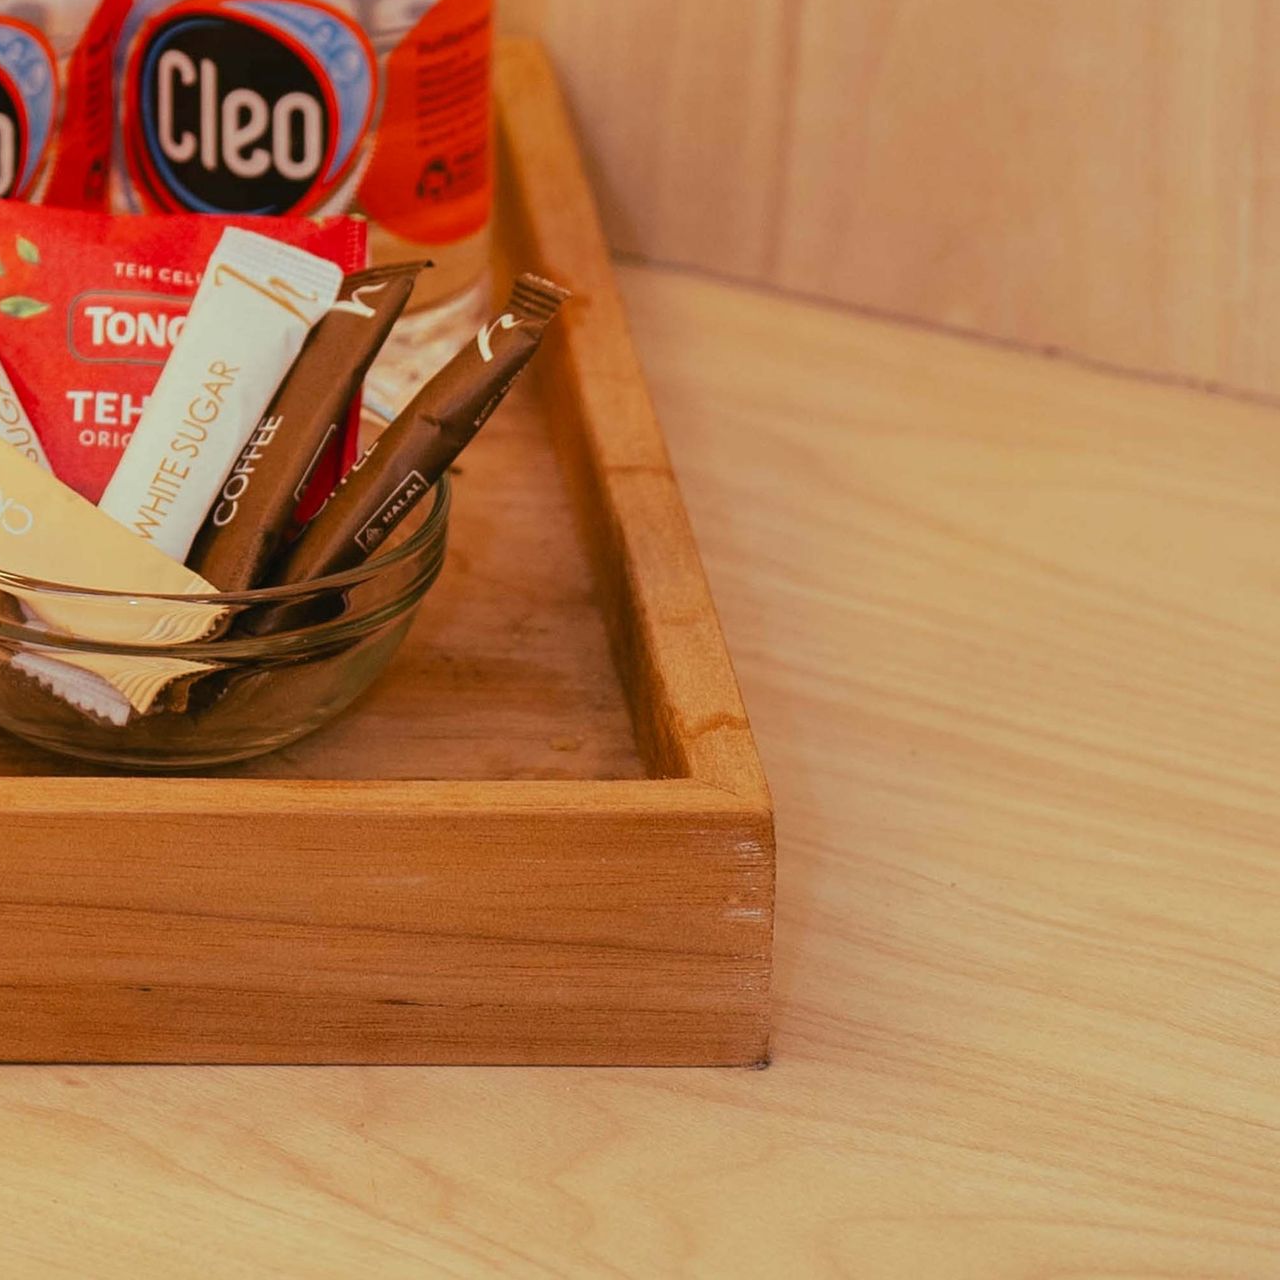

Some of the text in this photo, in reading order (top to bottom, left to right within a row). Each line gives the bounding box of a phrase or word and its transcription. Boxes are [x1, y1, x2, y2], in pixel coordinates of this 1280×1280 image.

[157, 48, 324, 181] Cleo
[114, 262, 204, 287] TEH CEL
[66, 390, 151, 426] TEH
[132, 359, 241, 540] WHITE SUGAR
[213, 414, 285, 527] COFFEE
[381, 480, 425, 524] HALAL
